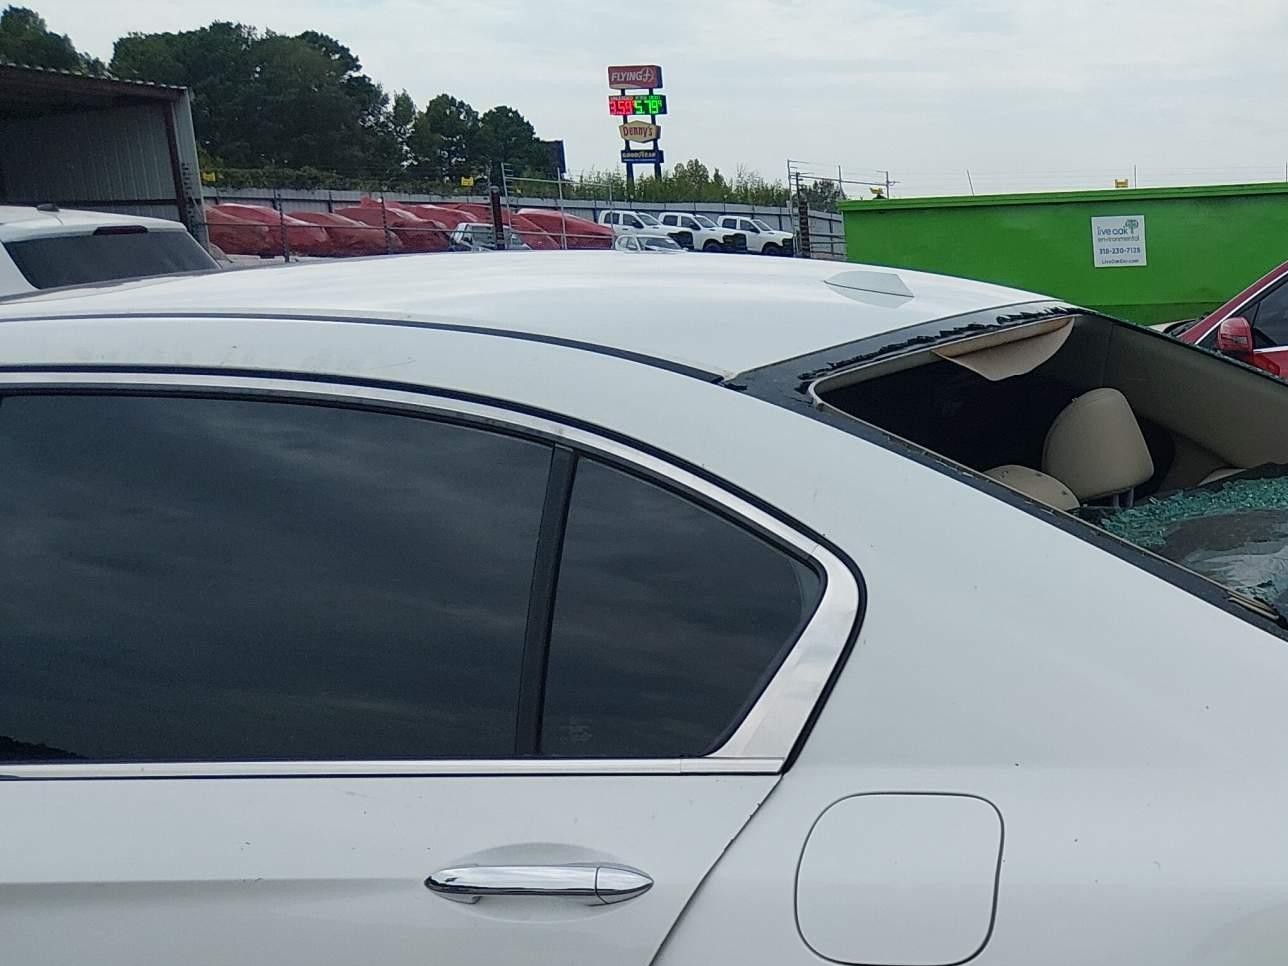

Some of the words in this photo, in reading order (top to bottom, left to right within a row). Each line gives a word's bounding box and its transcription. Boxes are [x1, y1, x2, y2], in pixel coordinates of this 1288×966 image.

[611, 71, 642, 82] FLYING
[623, 126, 653, 137] Denny's
[1097, 226, 1111, 235] live
[1112, 225, 1128, 235] oak
